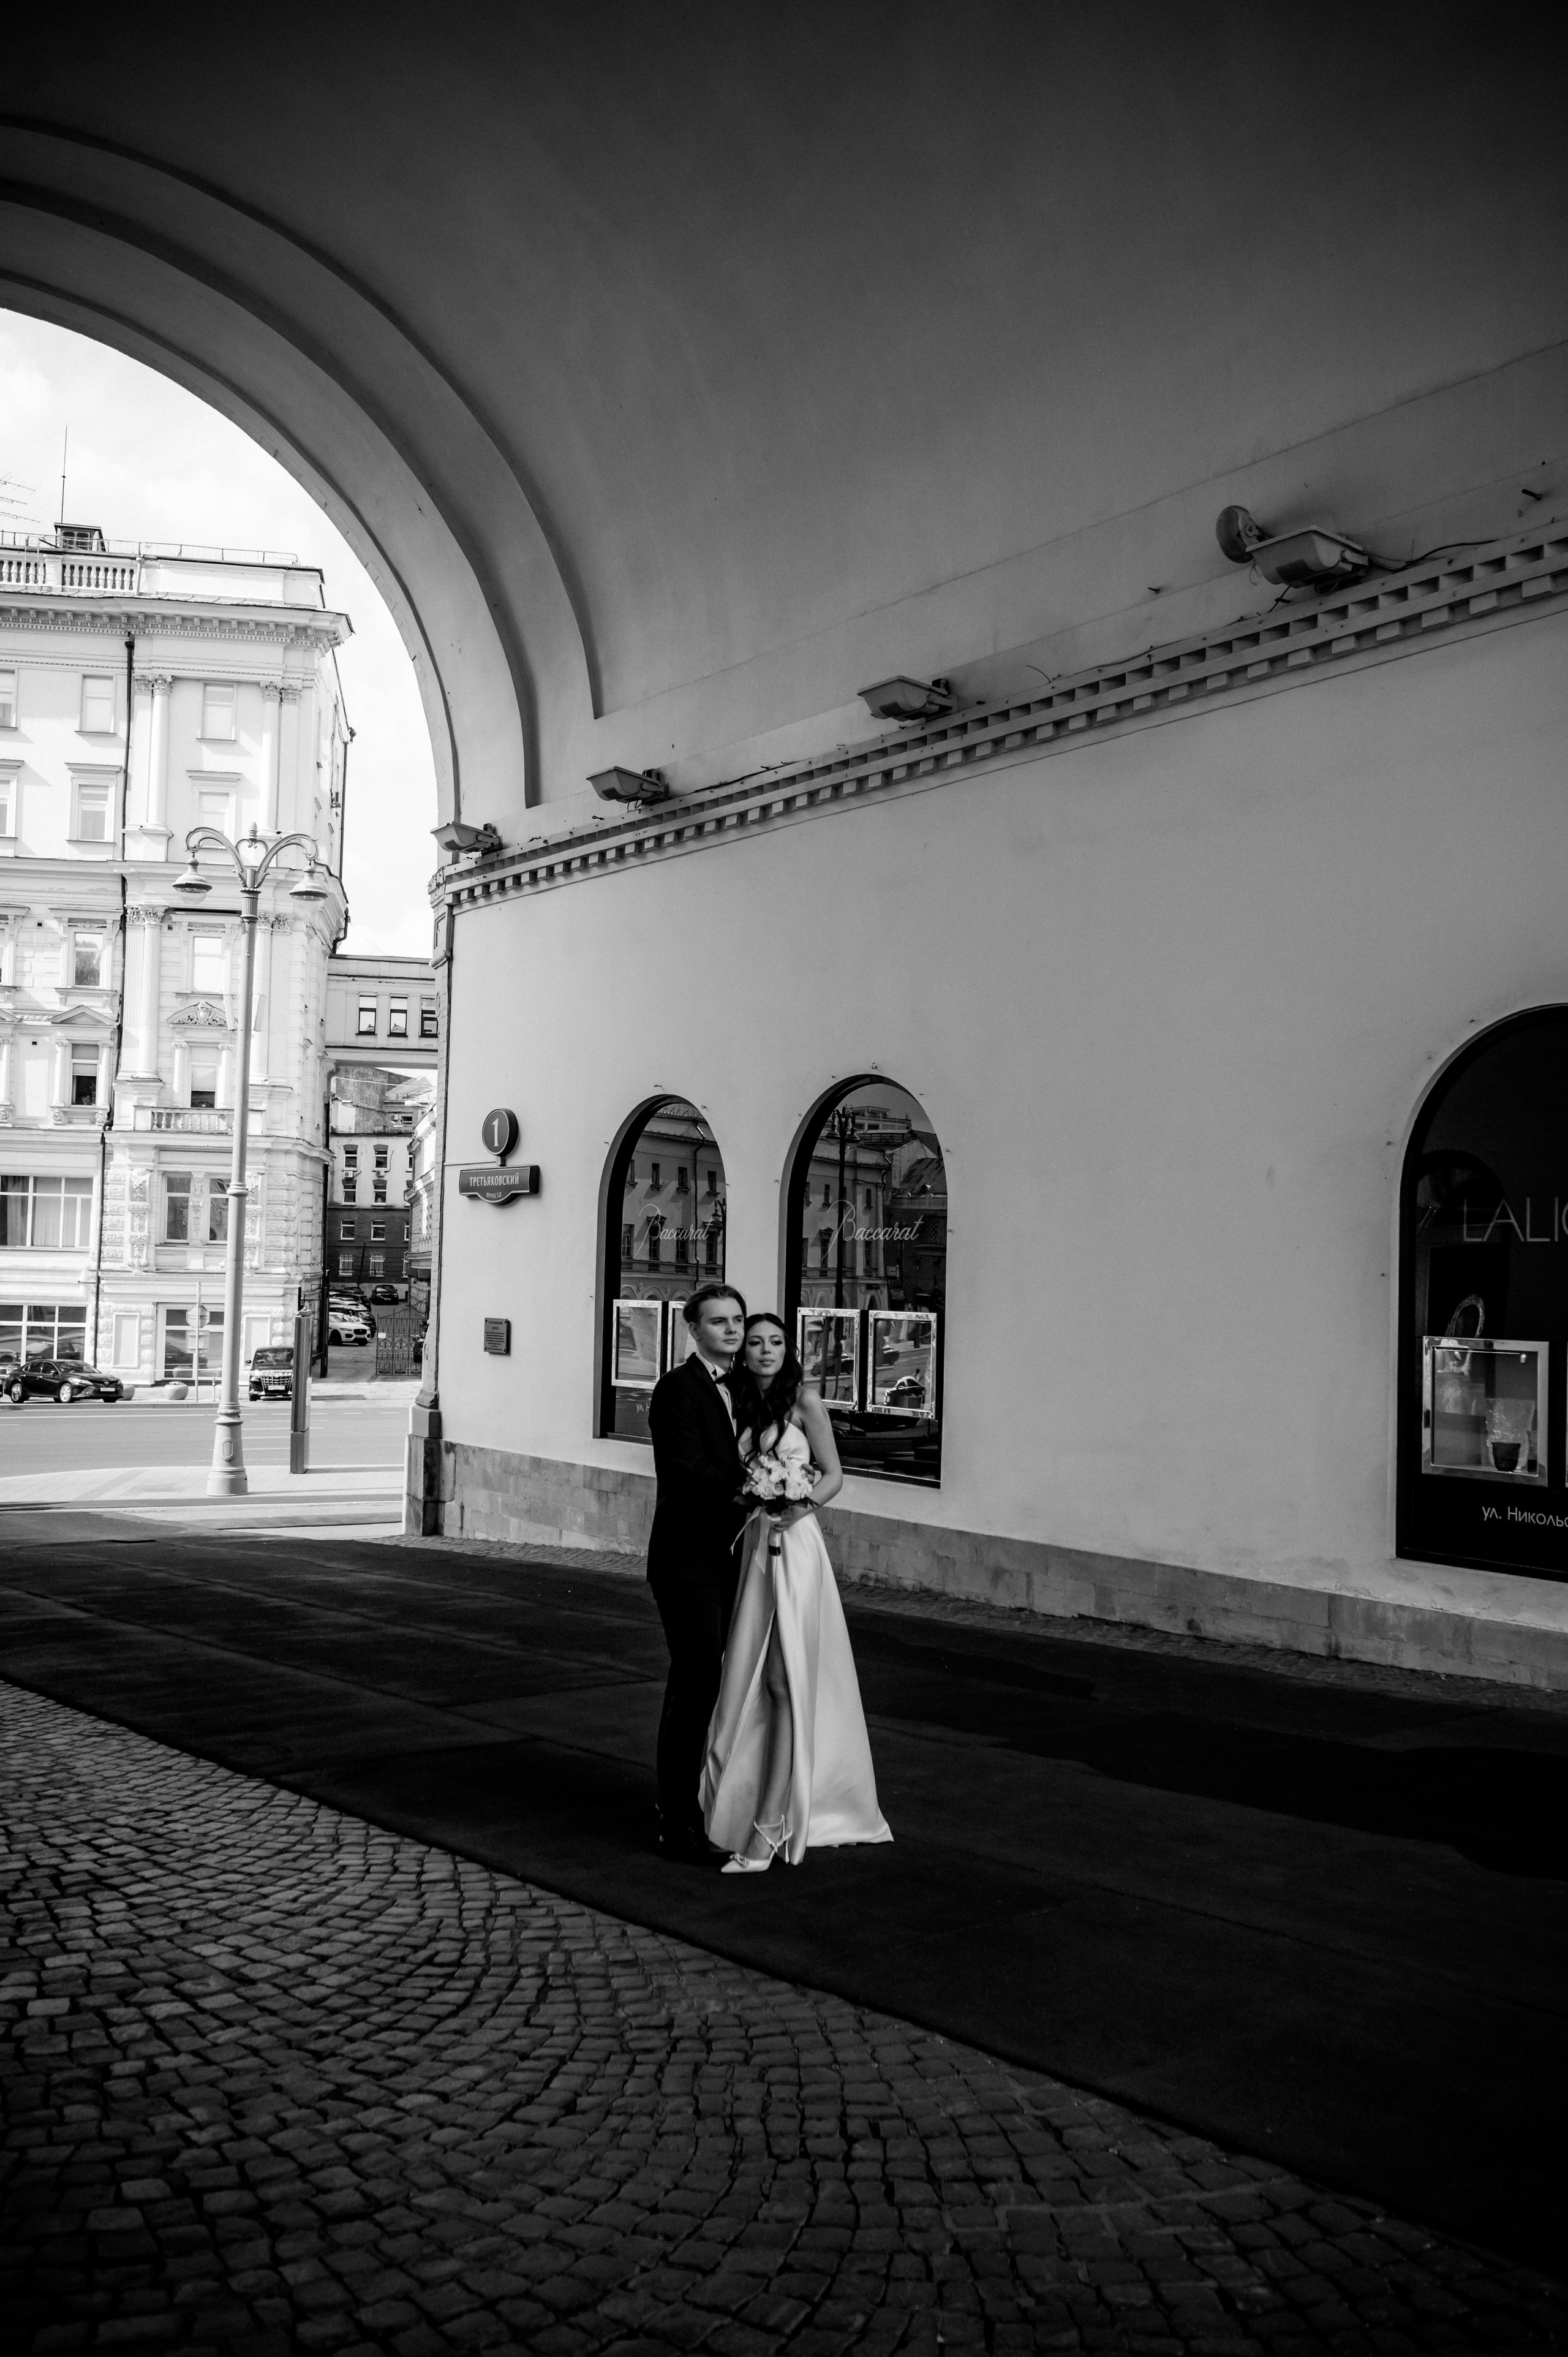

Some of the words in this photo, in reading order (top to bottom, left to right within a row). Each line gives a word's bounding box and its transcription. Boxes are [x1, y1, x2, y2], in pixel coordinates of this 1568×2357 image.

[492, 1118, 499, 1147] 1
[469, 1172, 519, 1187] ТРЕТЬЯКОВСКИЙ
[633, 1203, 715, 1258] Baccarat
[821, 1199, 924, 1261] Baccarat
[1463, 1197, 1568, 1242] LALI
[636, 1403, 644, 1413] ул.
[1481, 1506, 1502, 1521] ул.
